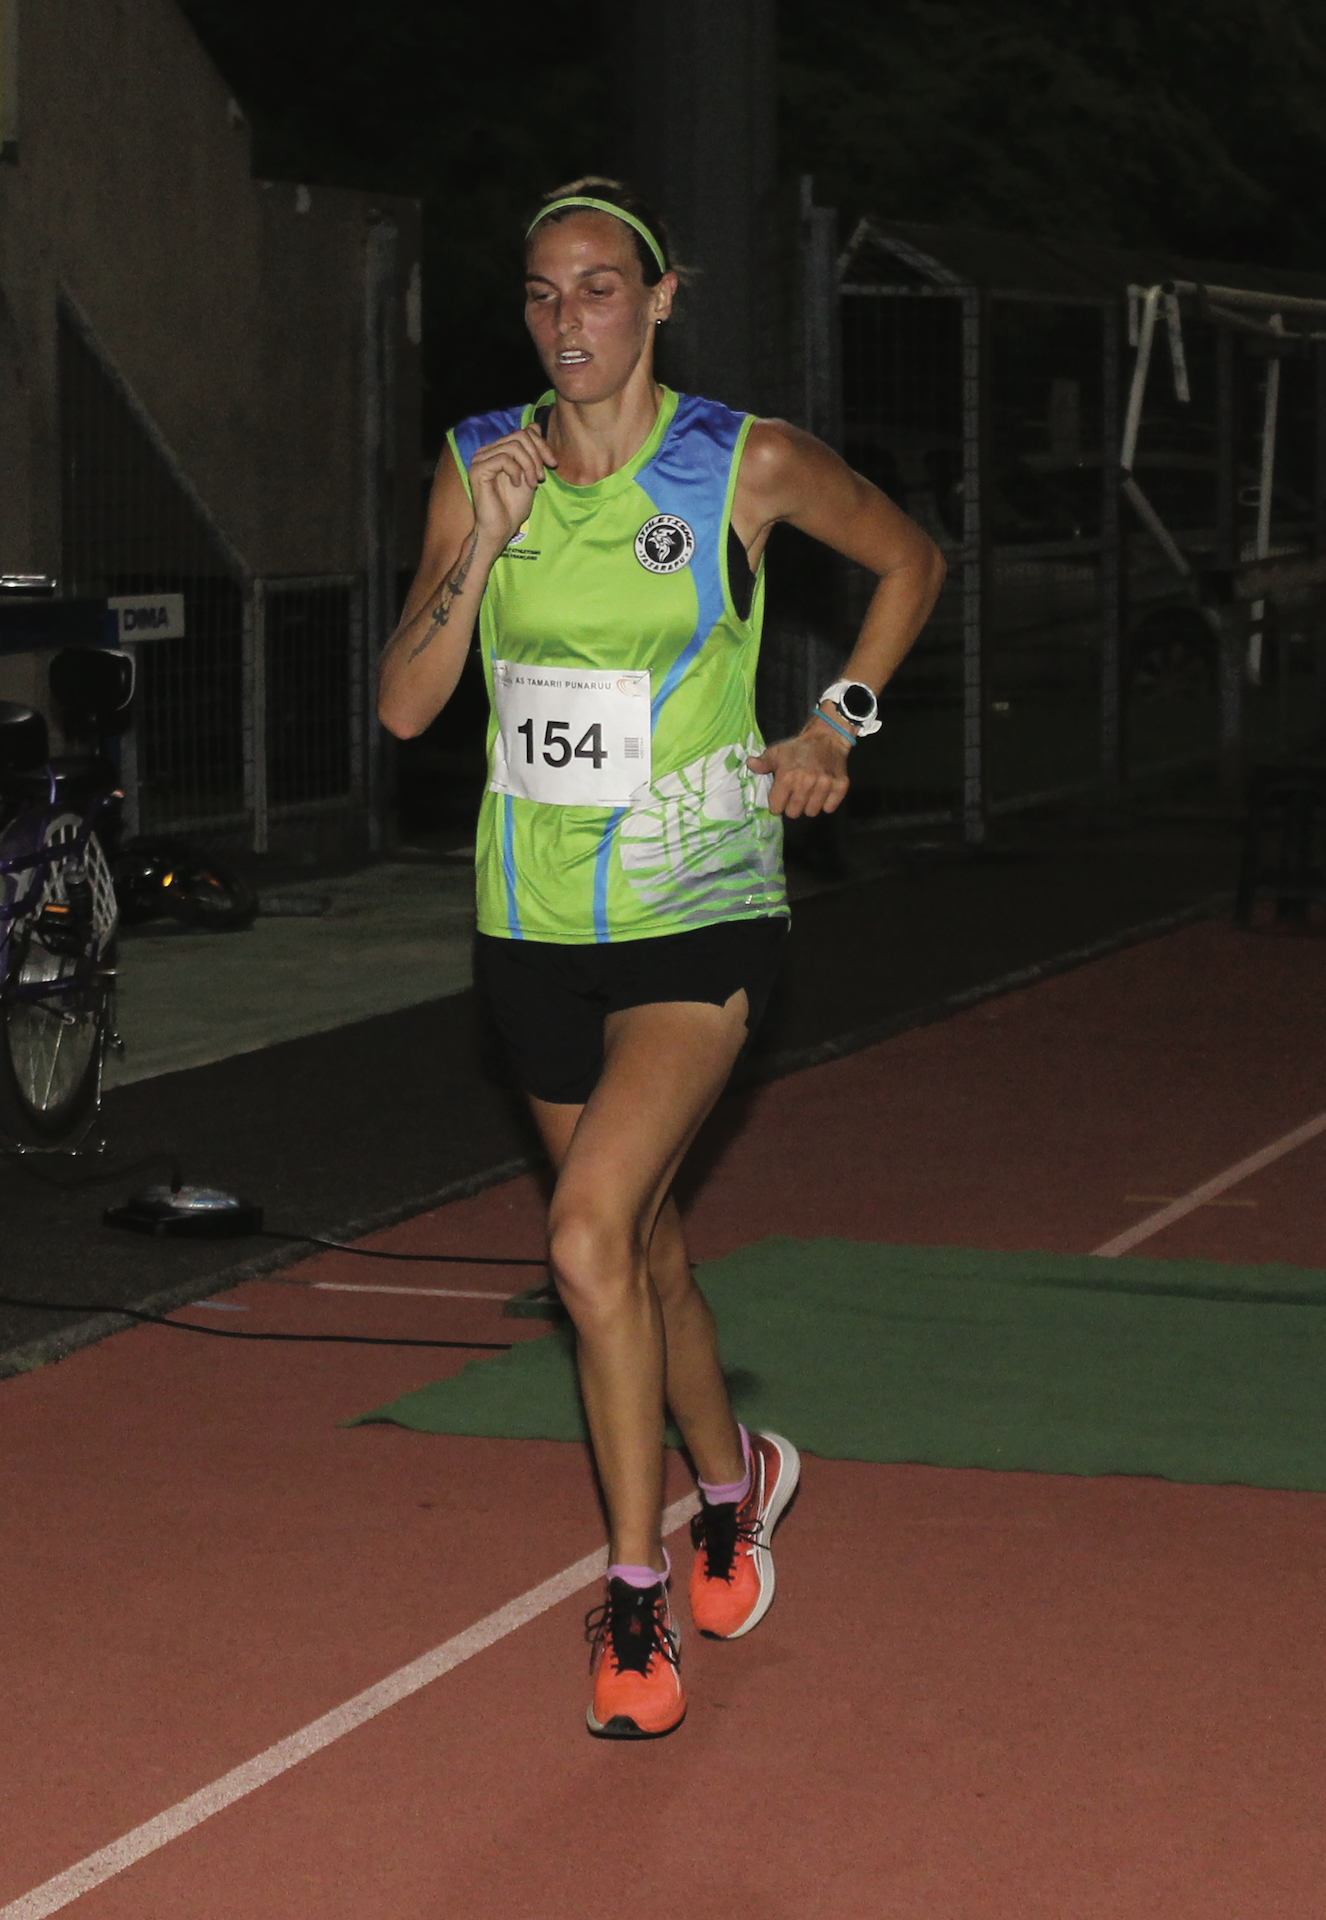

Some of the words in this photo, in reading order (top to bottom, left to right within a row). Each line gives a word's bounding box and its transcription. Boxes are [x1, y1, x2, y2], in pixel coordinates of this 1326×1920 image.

[639, 554, 686, 572] TAIARAPU
[124, 606, 168, 631] DIMA
[515, 677, 525, 685] AS
[527, 678, 562, 688] TAMARII
[565, 681, 612, 690] PUNARUU
[517, 718, 608, 769] 154
